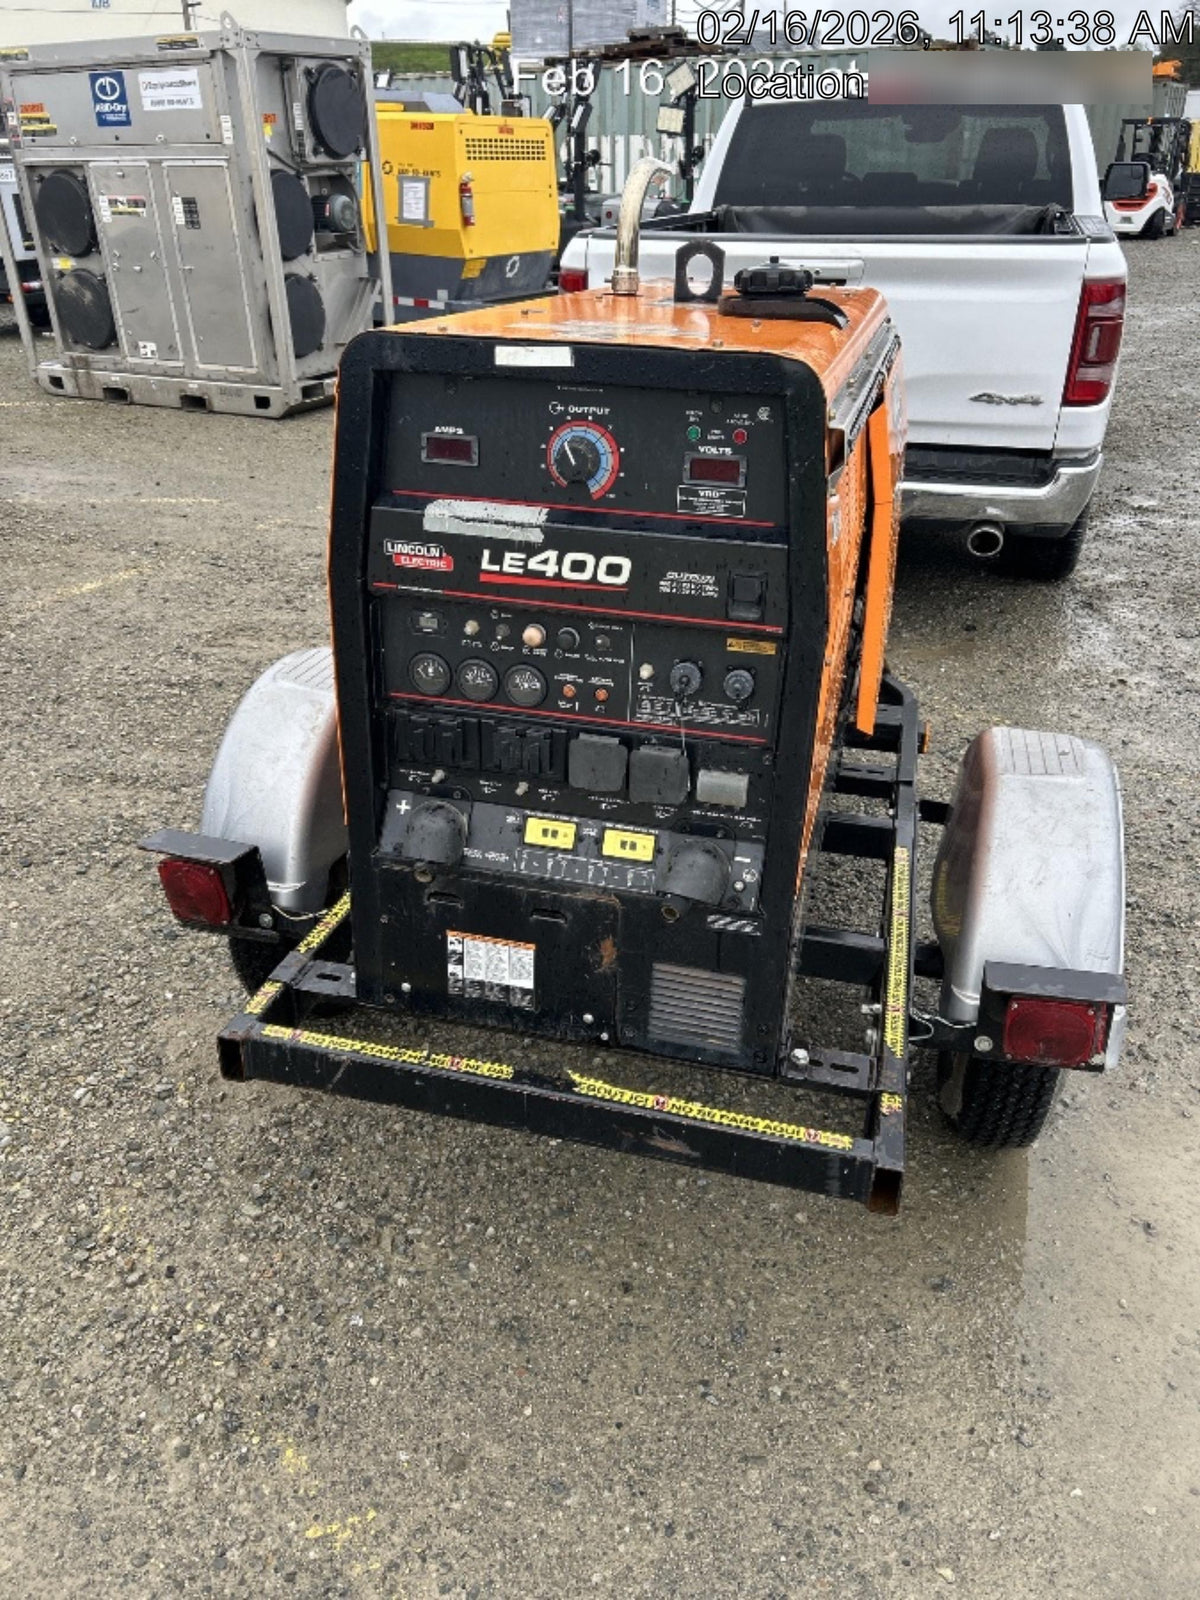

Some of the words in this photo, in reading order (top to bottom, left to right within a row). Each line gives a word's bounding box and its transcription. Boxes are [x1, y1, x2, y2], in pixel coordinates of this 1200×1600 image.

[568, 404, 611, 415] OUTPUT
[698, 445, 733, 456] VOLTS
[386, 541, 441, 558] LINCOLN
[400, 555, 448, 569] ELECTRIC
[480, 548, 633, 585] LE400
[328, 1037, 359, 1050] NOT
[671, 1102, 694, 1115] NO
